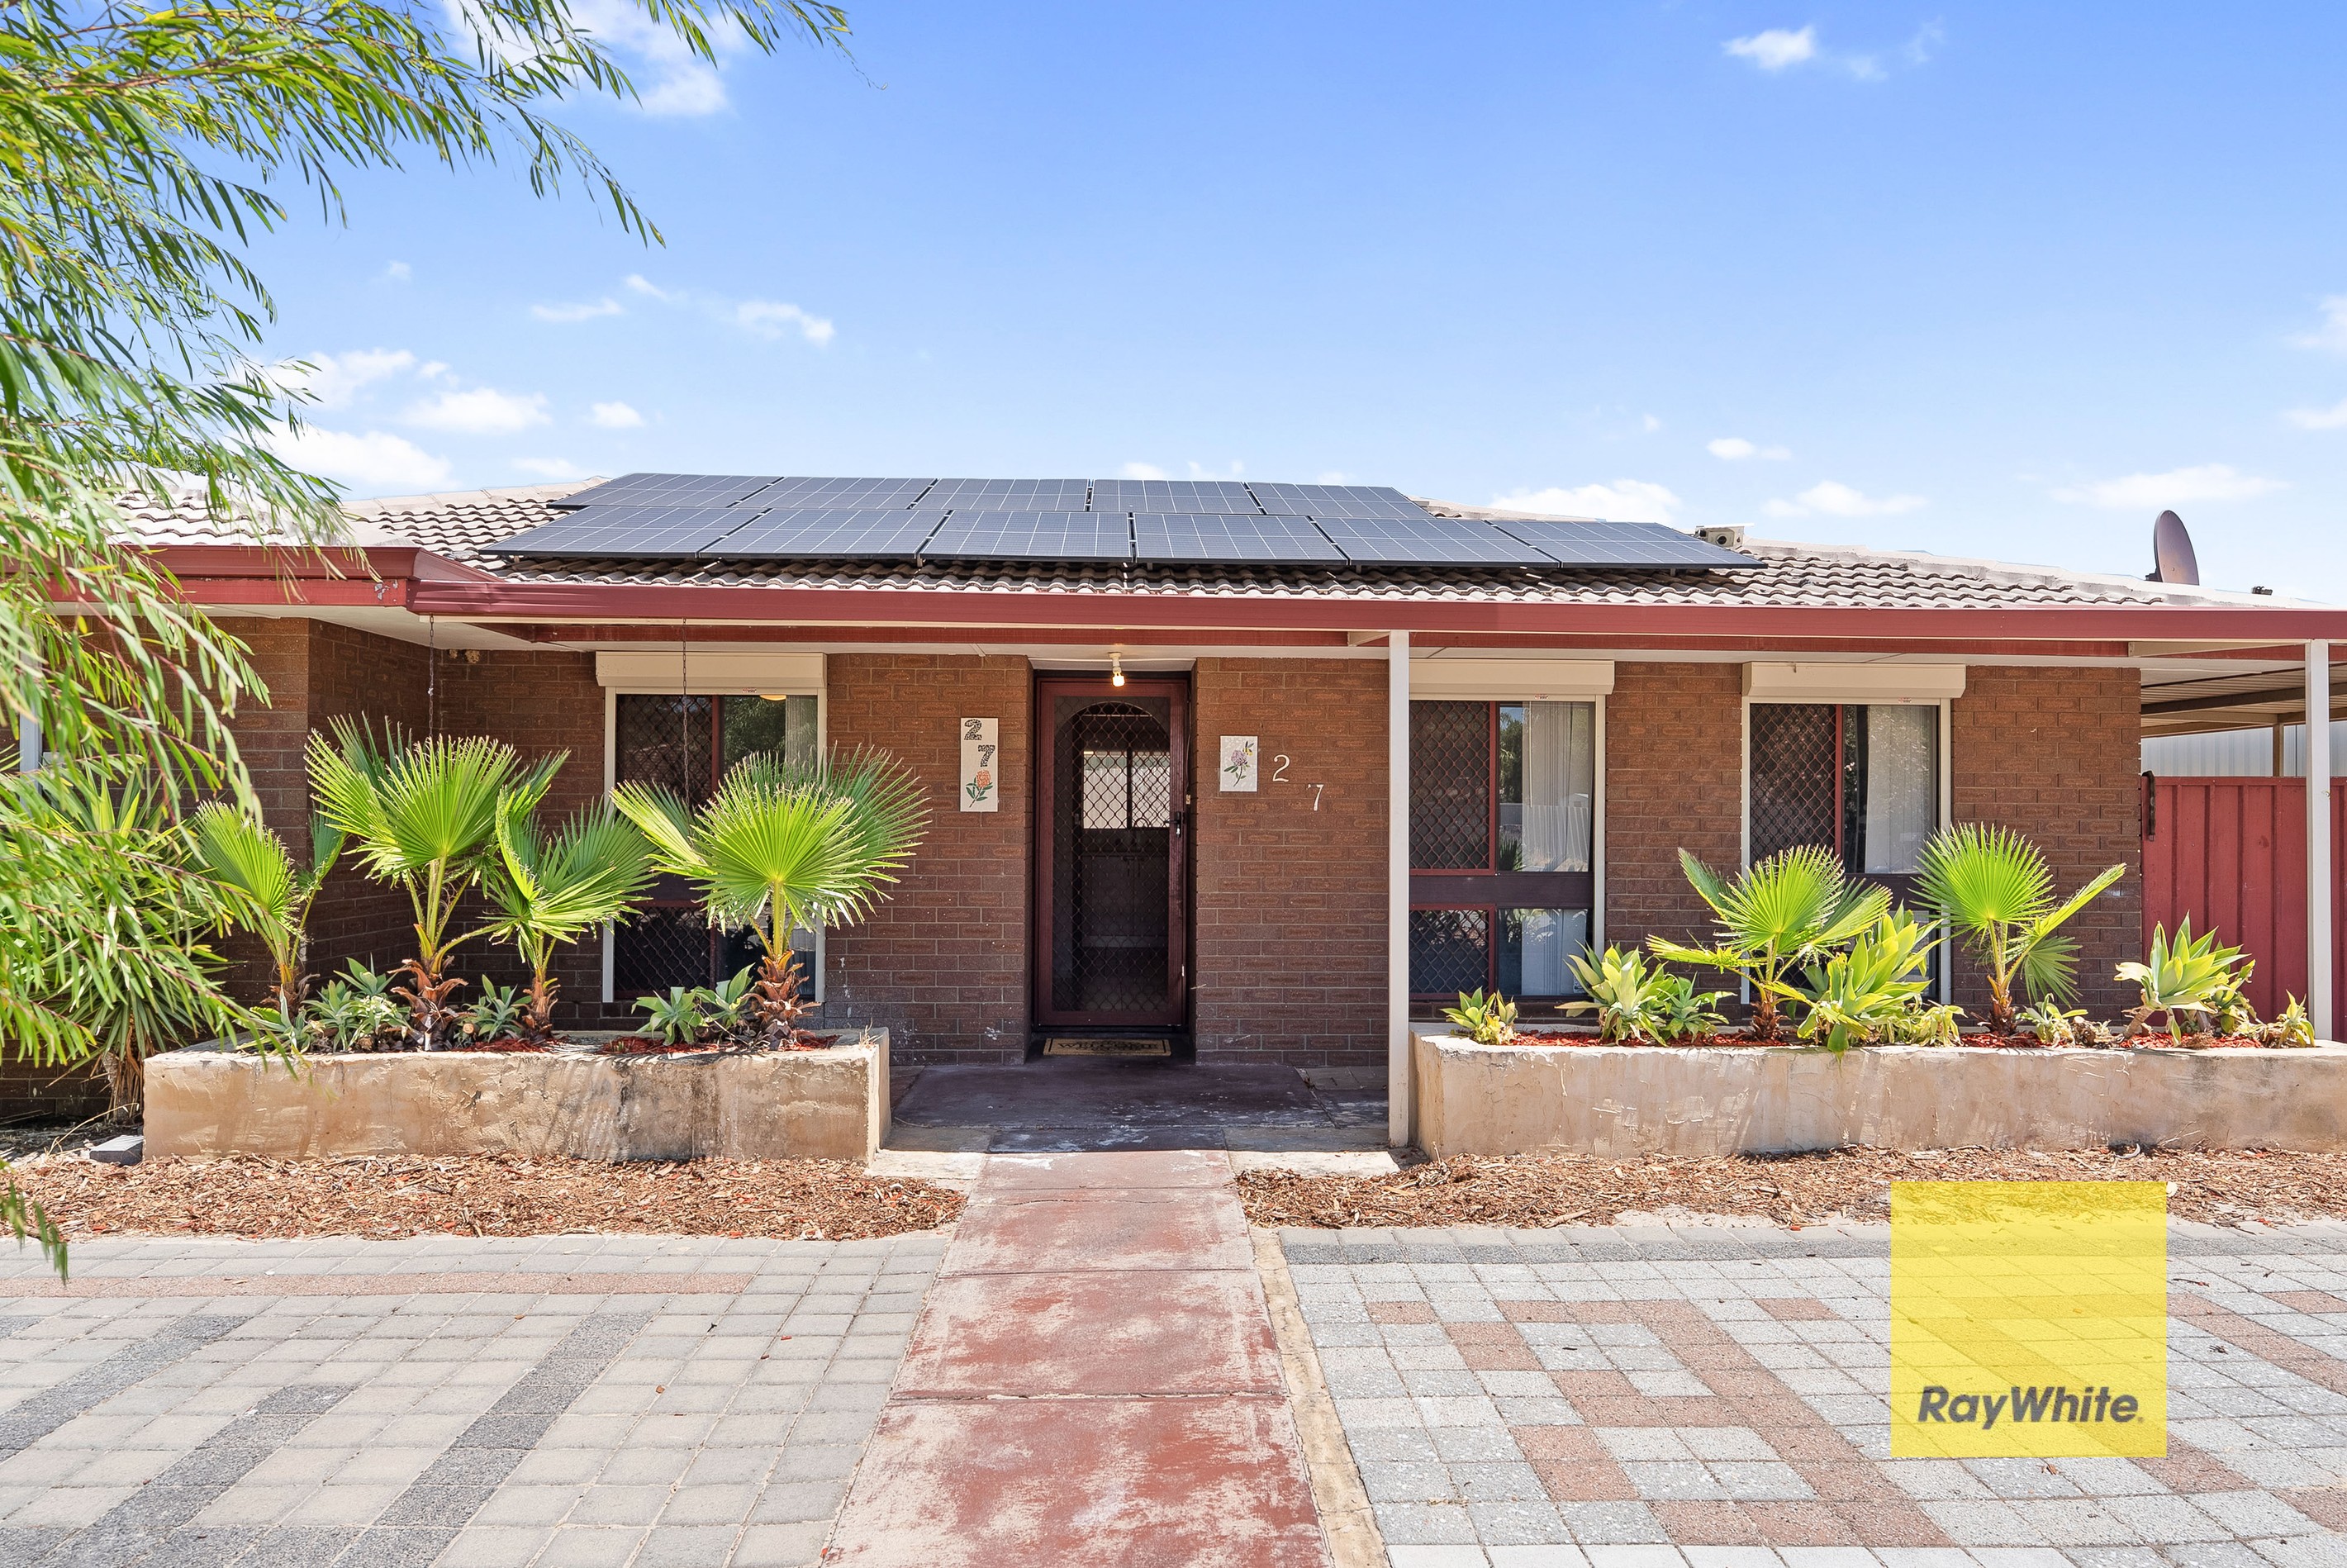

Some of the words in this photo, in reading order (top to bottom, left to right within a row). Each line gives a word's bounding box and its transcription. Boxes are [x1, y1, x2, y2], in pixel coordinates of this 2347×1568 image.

[964, 719, 982, 740] 2
[978, 744, 995, 767] 7
[1273, 754, 1290, 782] 2
[1306, 784, 1324, 811] 7
